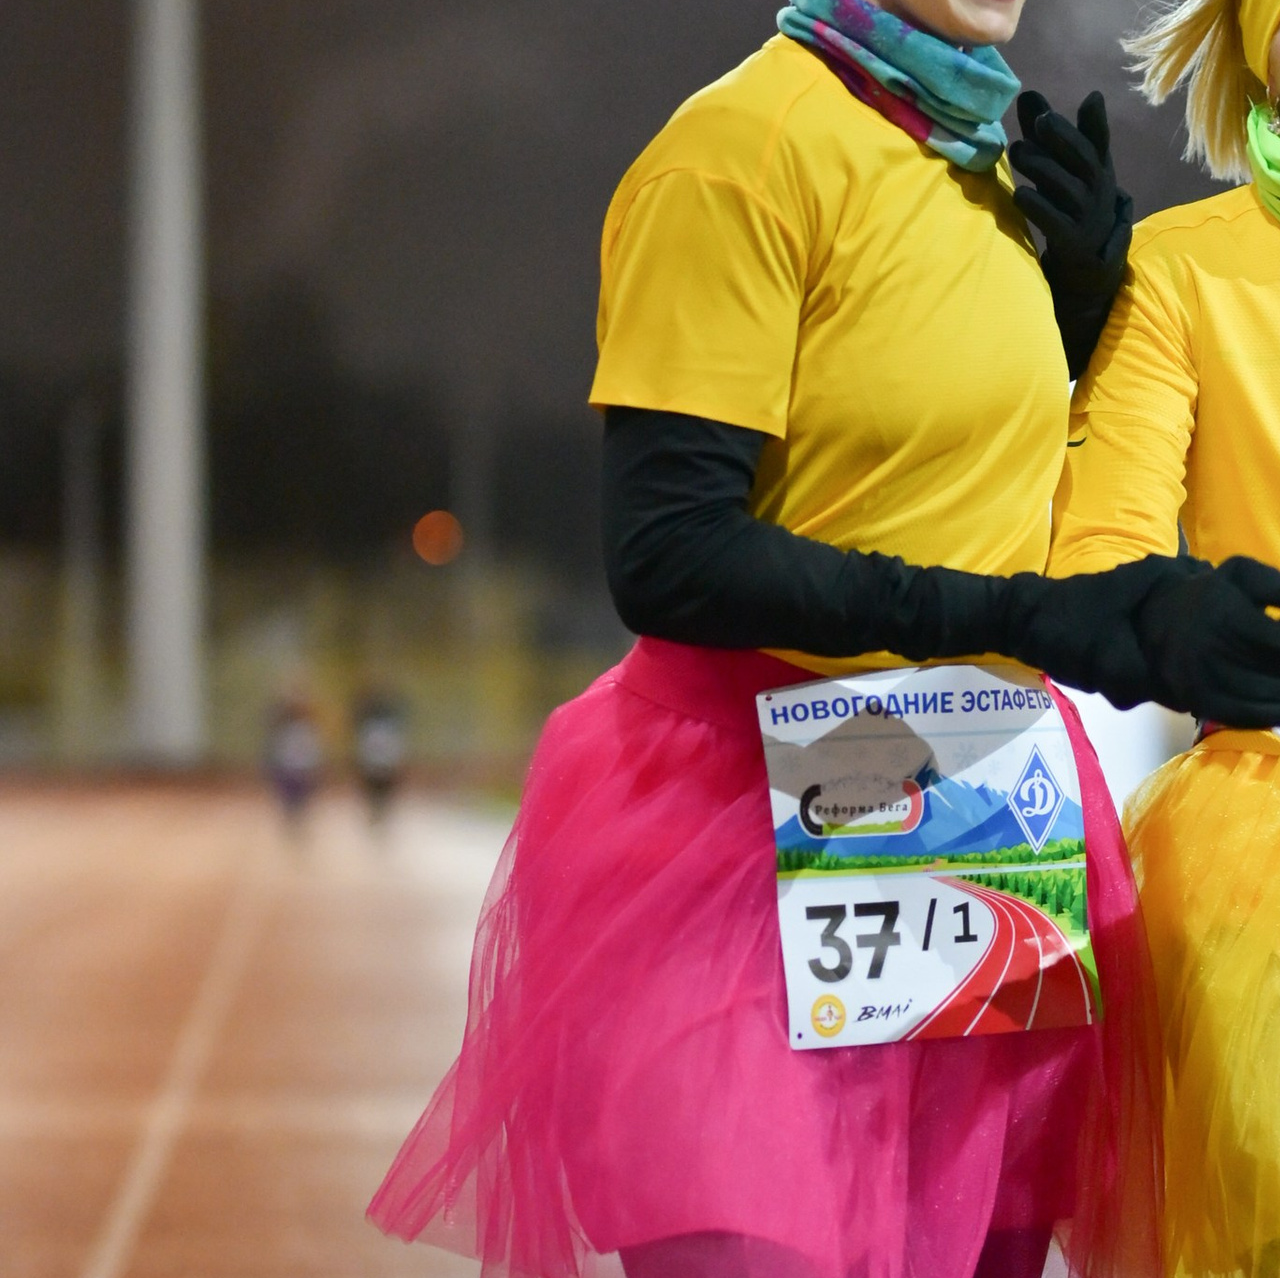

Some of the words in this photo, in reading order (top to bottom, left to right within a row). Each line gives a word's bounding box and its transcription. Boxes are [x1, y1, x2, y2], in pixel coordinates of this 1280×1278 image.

[771, 691, 954, 725] НОВОГОДНИЕ
[814, 802, 874, 817] Реформа
[879, 802, 909, 814] Бега
